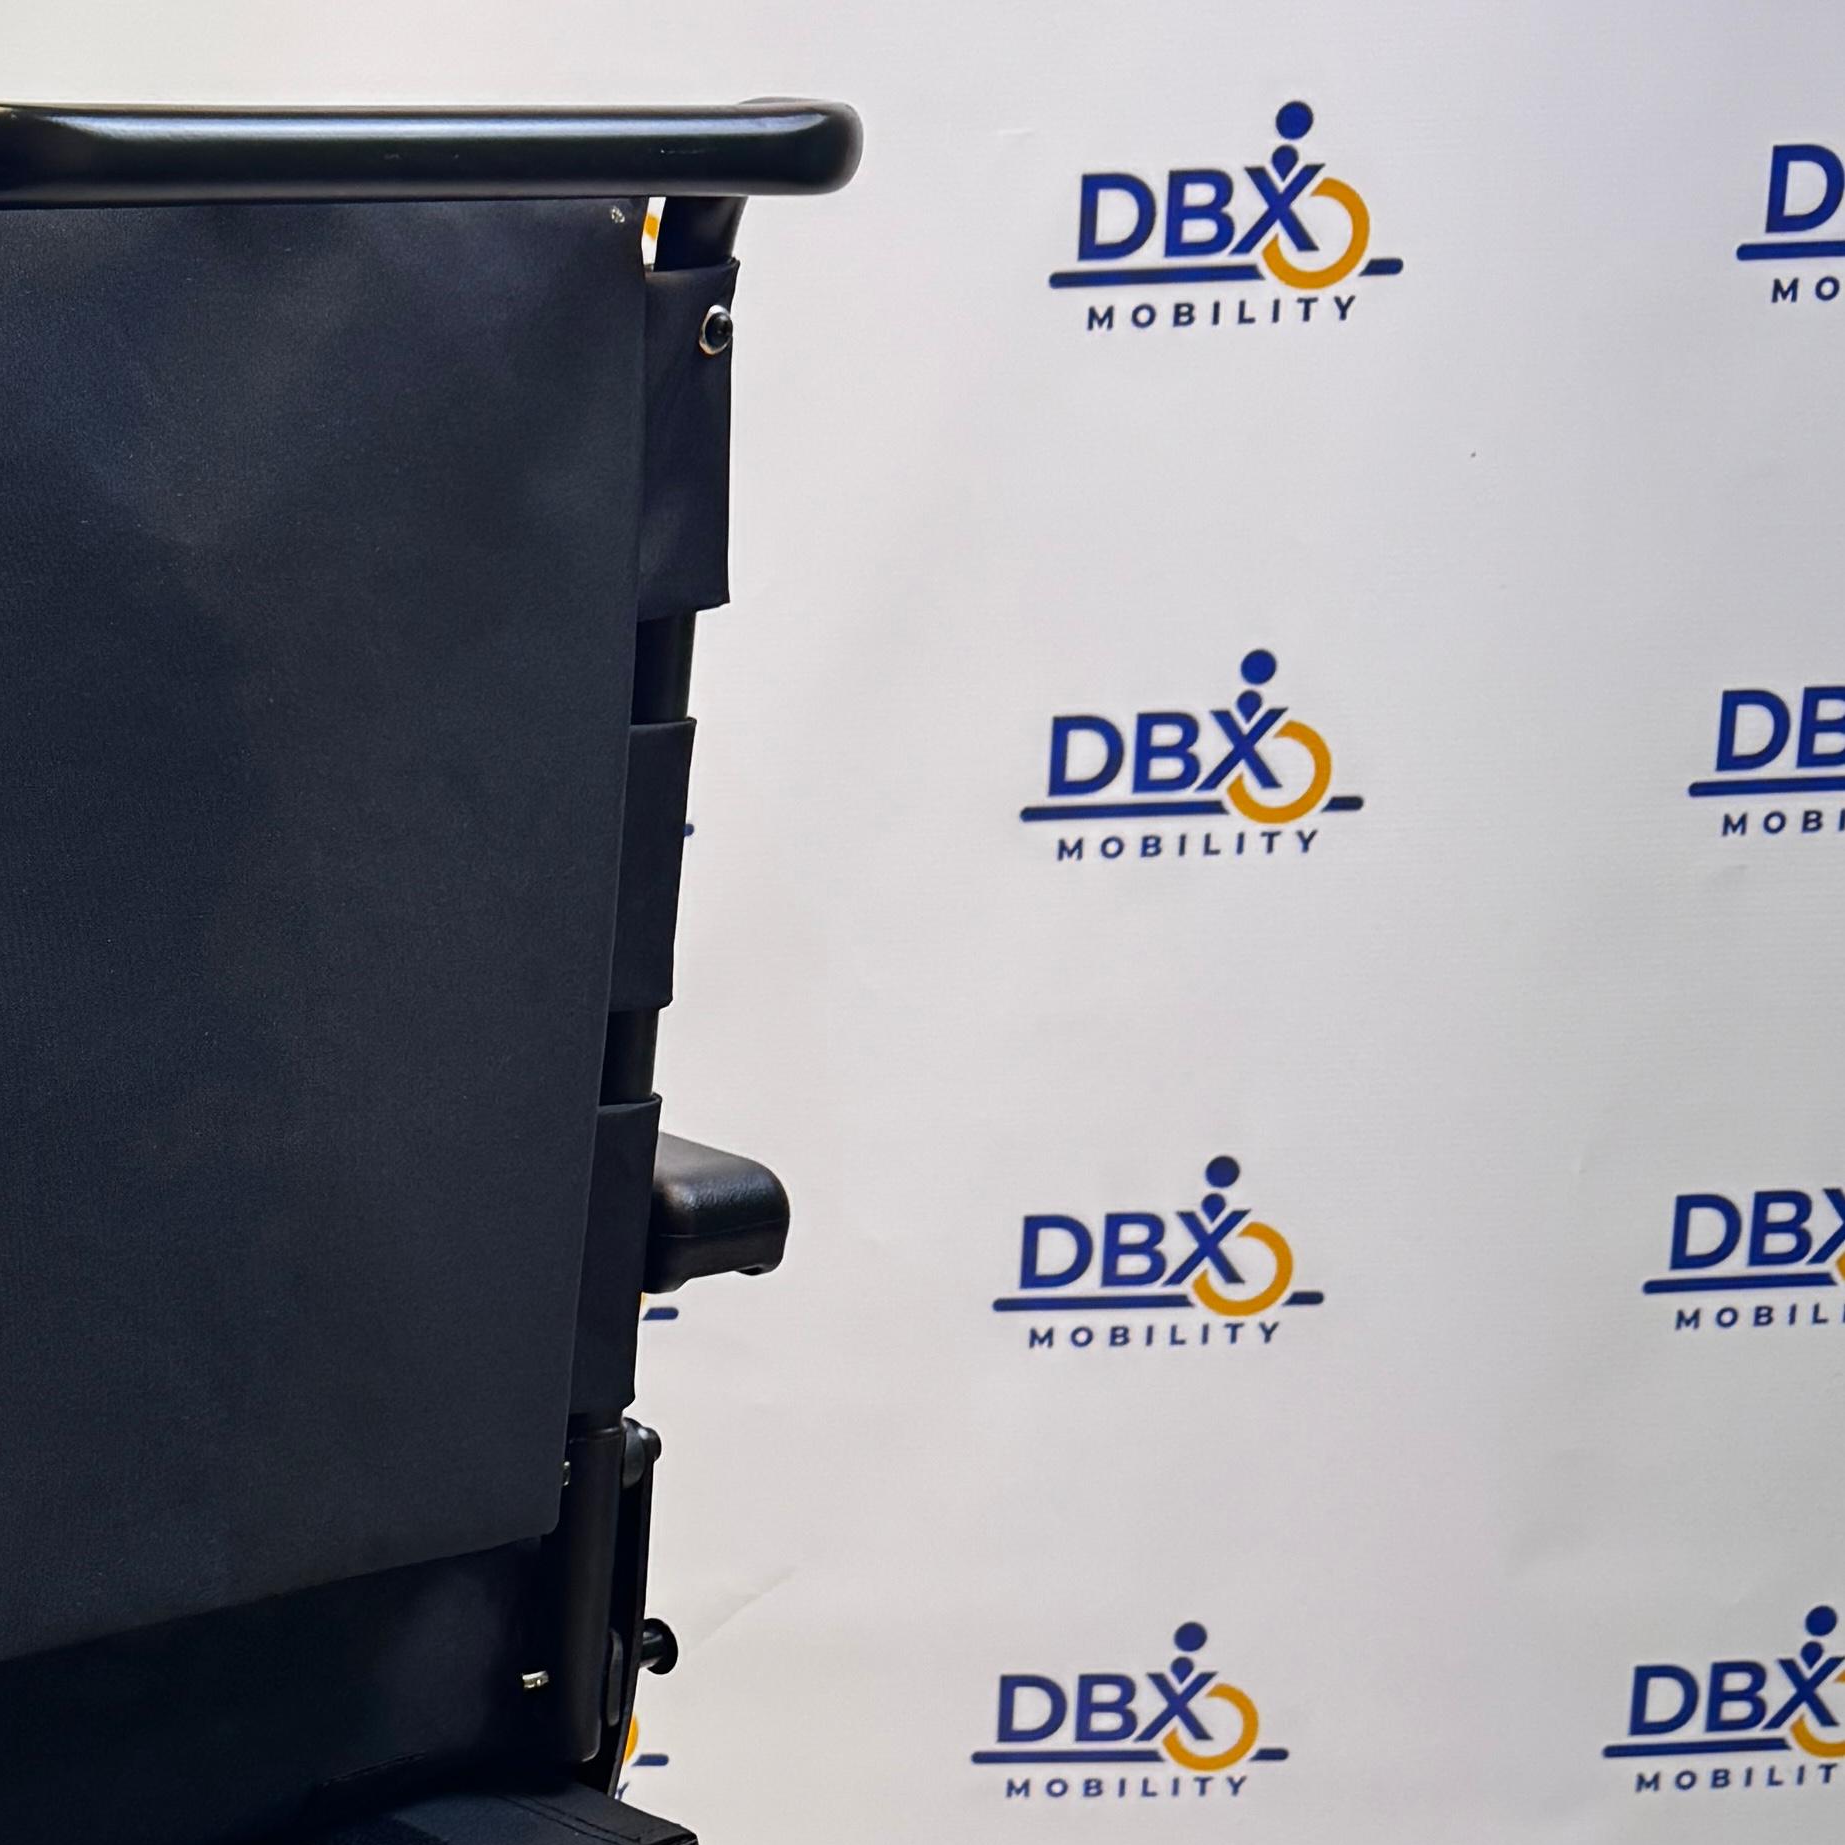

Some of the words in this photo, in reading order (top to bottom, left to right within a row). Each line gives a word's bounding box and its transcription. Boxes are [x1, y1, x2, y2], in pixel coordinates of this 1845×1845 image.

[1076, 164, 1325, 260] DBX
[1086, 294, 1358, 331] MOBILITY
[1716, 686, 1845, 771] DB
[1049, 707, 1288, 796] DBX
[1722, 810, 1845, 836] MOBI
[1056, 827, 1321, 862] MOBILITY
[1019, 1207, 1252, 1289] DBX
[1029, 1320, 1281, 1350] MOBILITY
[1675, 1303, 1845, 1330] MOBIL
[998, 1670, 1215, 1744] DBX
[1629, 1656, 1845, 1736] DBX
[1005, 1773, 1248, 1798] MOBILITY
[1635, 1764, 1838, 1793] MOBILIT
